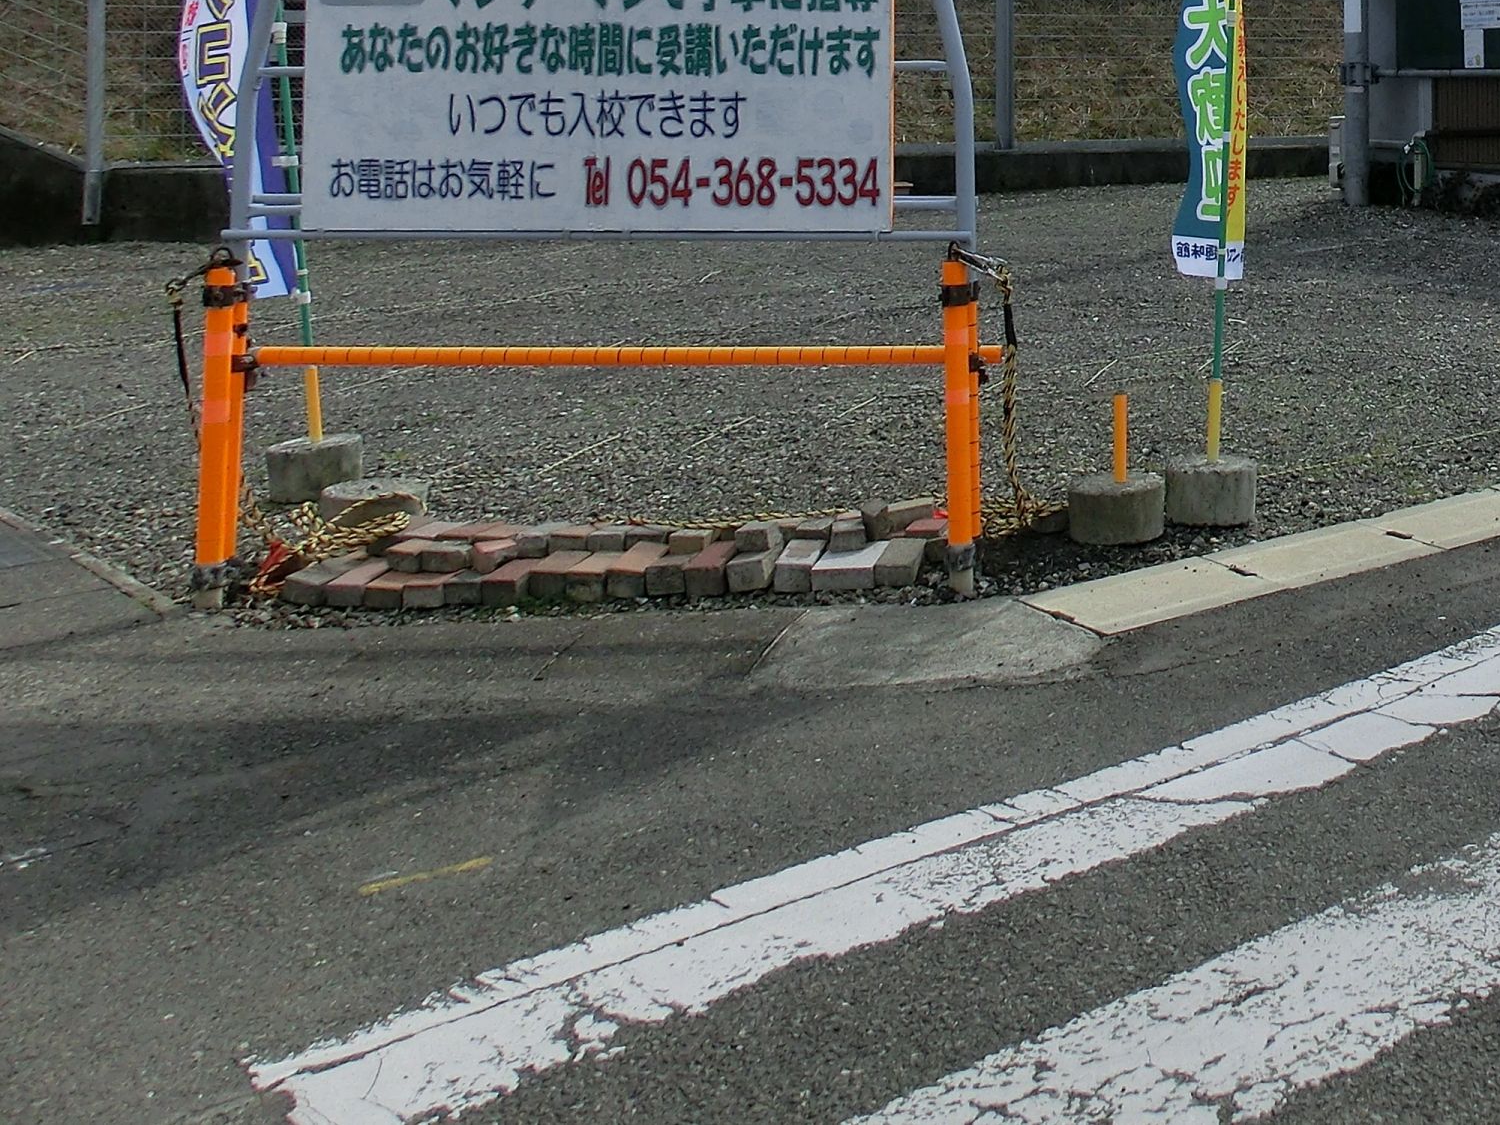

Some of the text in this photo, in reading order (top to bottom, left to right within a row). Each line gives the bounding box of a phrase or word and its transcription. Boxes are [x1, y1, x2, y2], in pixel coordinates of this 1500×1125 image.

[340, 22, 880, 77] あなたのお好きな時間に受講いただけます
[449, 90, 747, 139] いつでも入校できます
[330, 159, 556, 201] お電話はお気軽に
[627, 156, 880, 206] 054-368-5334
